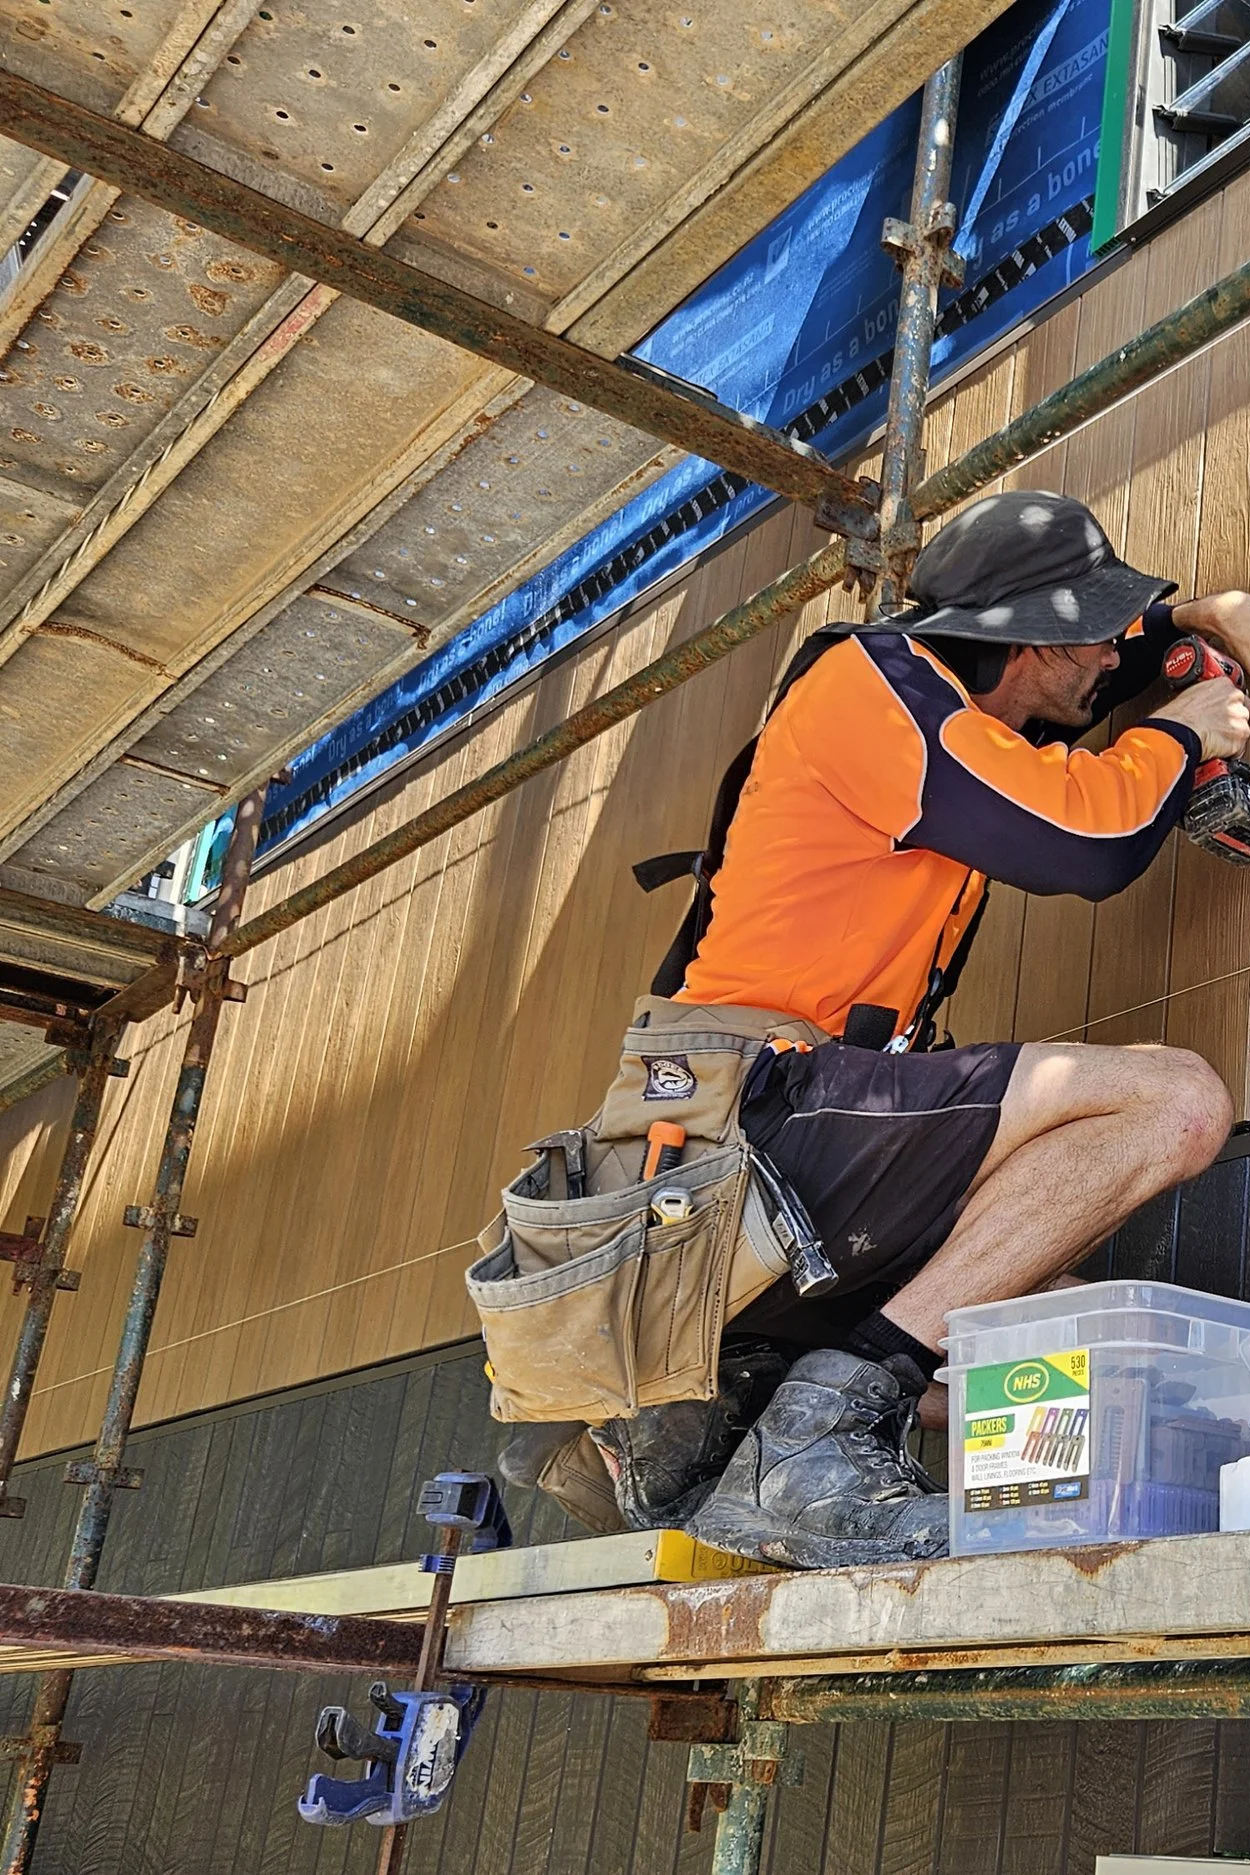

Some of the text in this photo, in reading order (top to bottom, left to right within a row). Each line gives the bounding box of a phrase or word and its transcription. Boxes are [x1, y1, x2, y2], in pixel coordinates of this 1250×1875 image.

[820, 351, 843, 384] as
[850, 336, 860, 358] a
[1071, 1355, 1086, 1370] 530
[1013, 1374, 1041, 1391] NHS
[971, 1417, 1007, 1437] PACKERS
